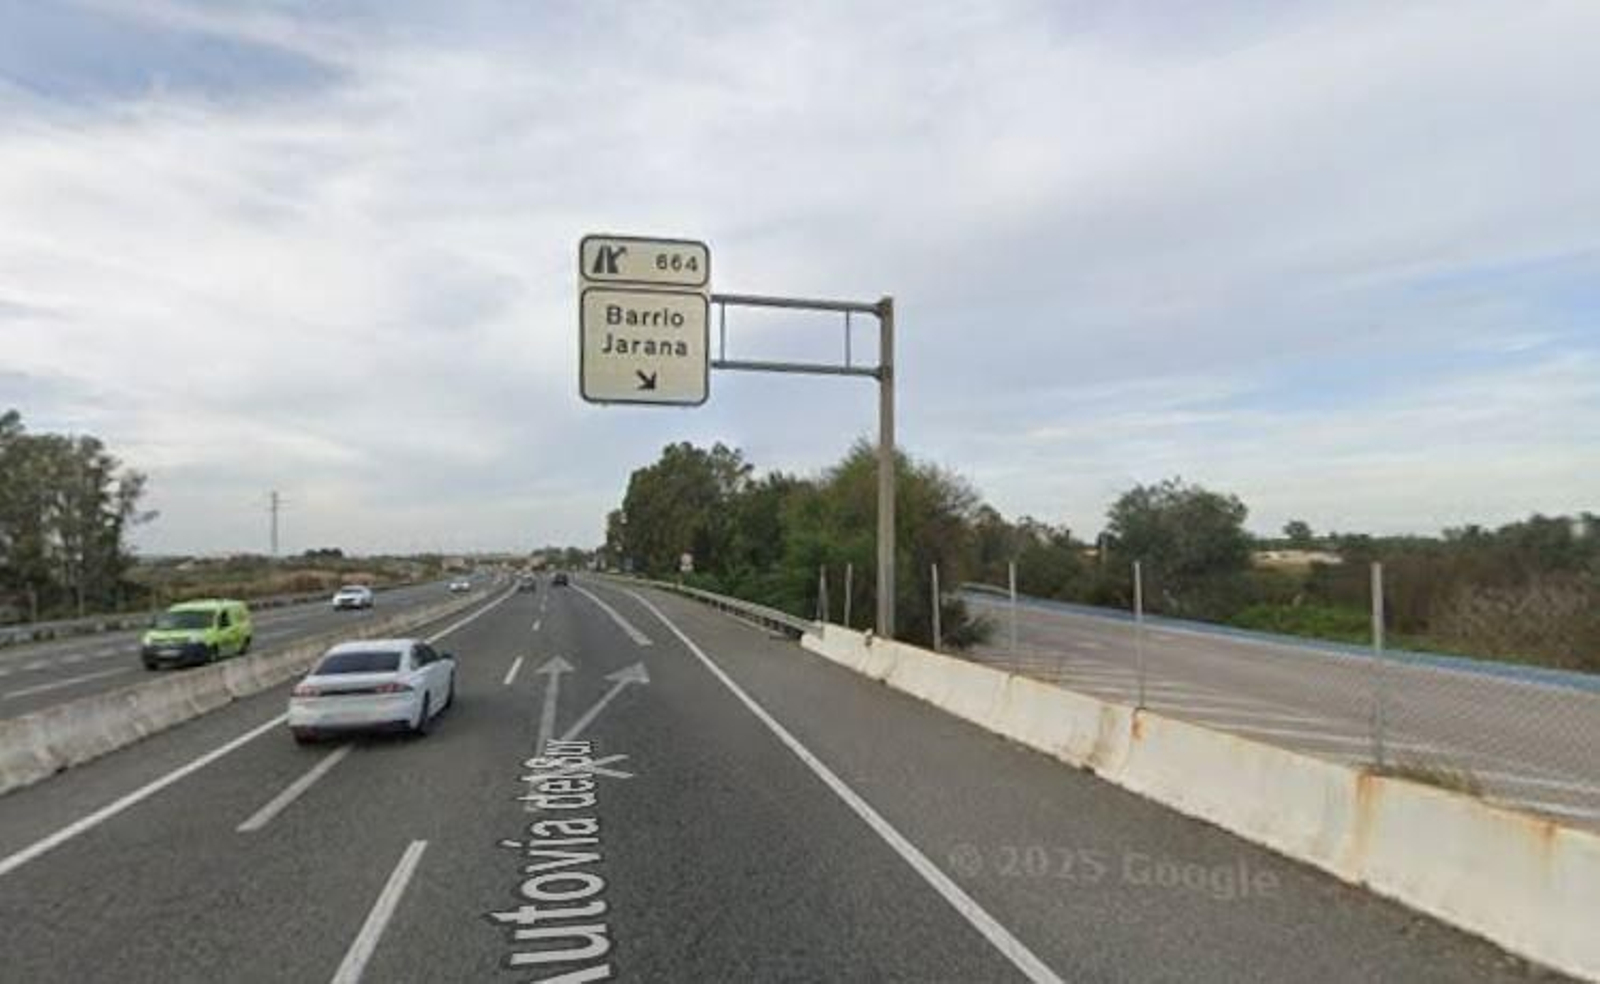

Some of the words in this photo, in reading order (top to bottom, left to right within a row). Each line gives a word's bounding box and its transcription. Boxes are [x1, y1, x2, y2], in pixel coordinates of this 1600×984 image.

[655, 253, 698, 272] 664
[606, 304, 685, 328] Barrio
[602, 333, 688, 356] Jarana
